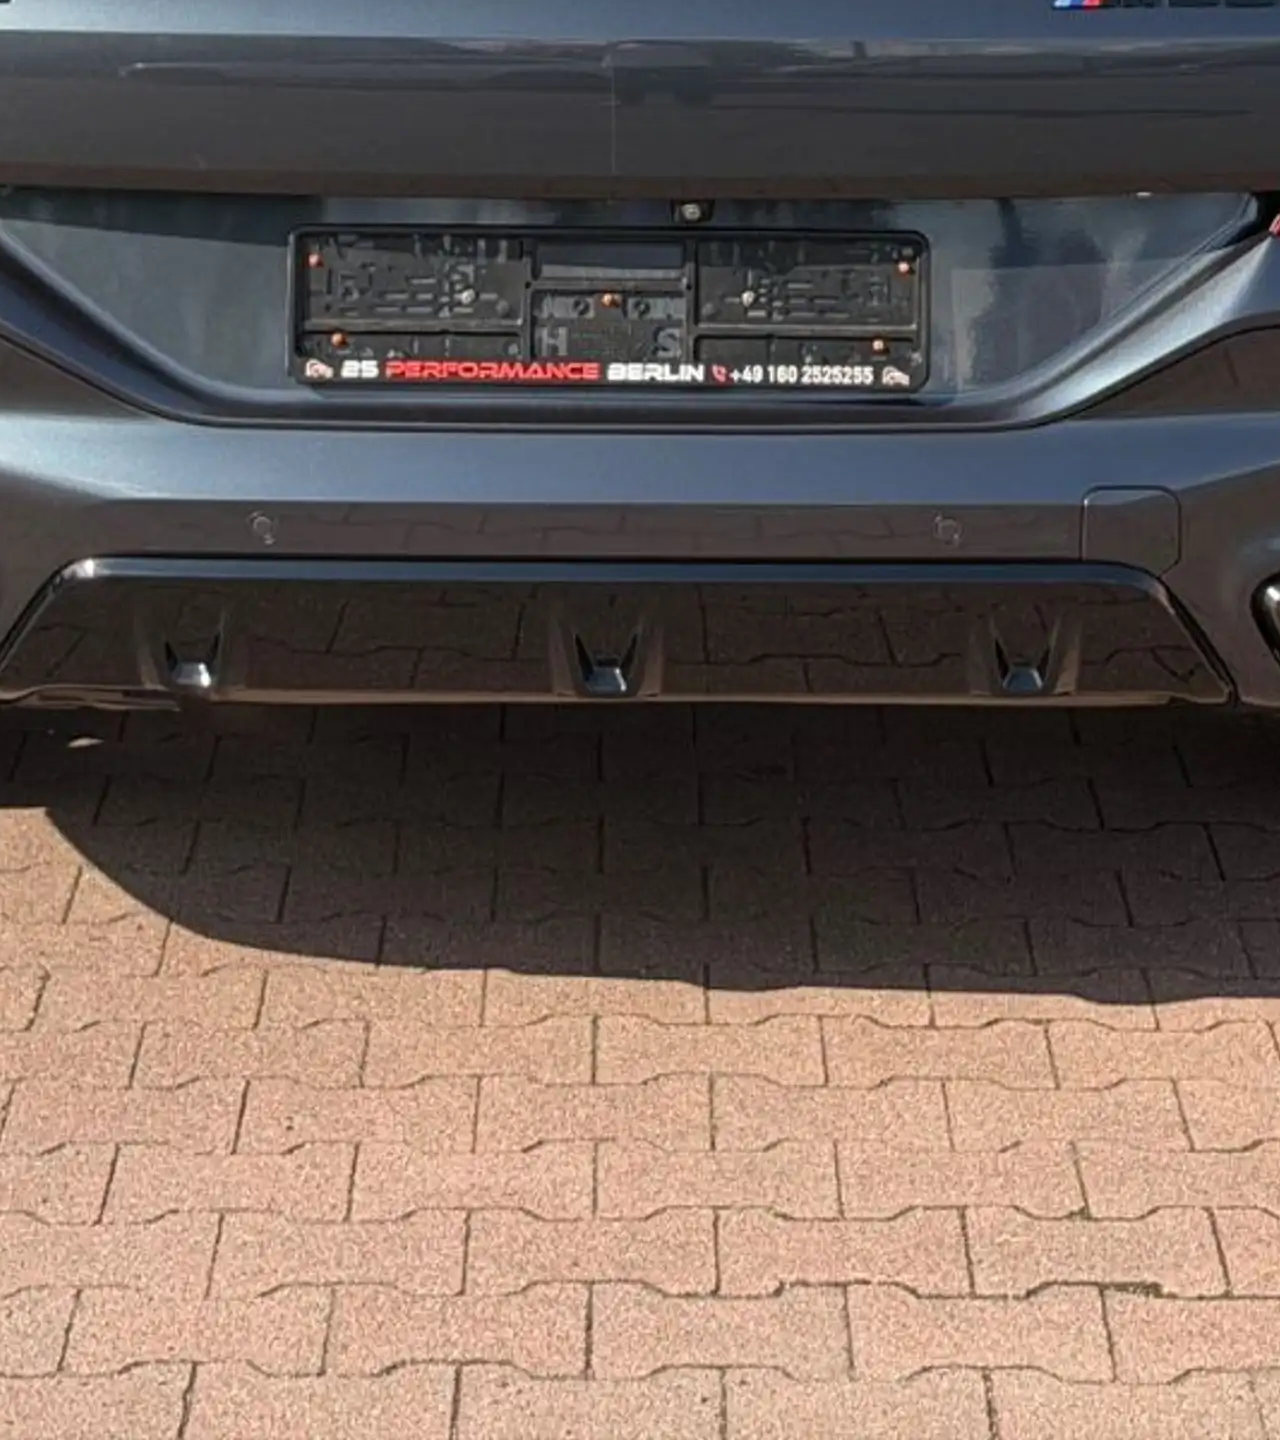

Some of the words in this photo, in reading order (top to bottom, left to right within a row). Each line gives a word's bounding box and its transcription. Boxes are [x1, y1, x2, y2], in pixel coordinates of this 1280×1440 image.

[385, 360, 601, 381] PERFORMANCE
[606, 362, 705, 382] BERLIN
[730, 364, 764, 384] +49
[767, 364, 799, 385] 160
